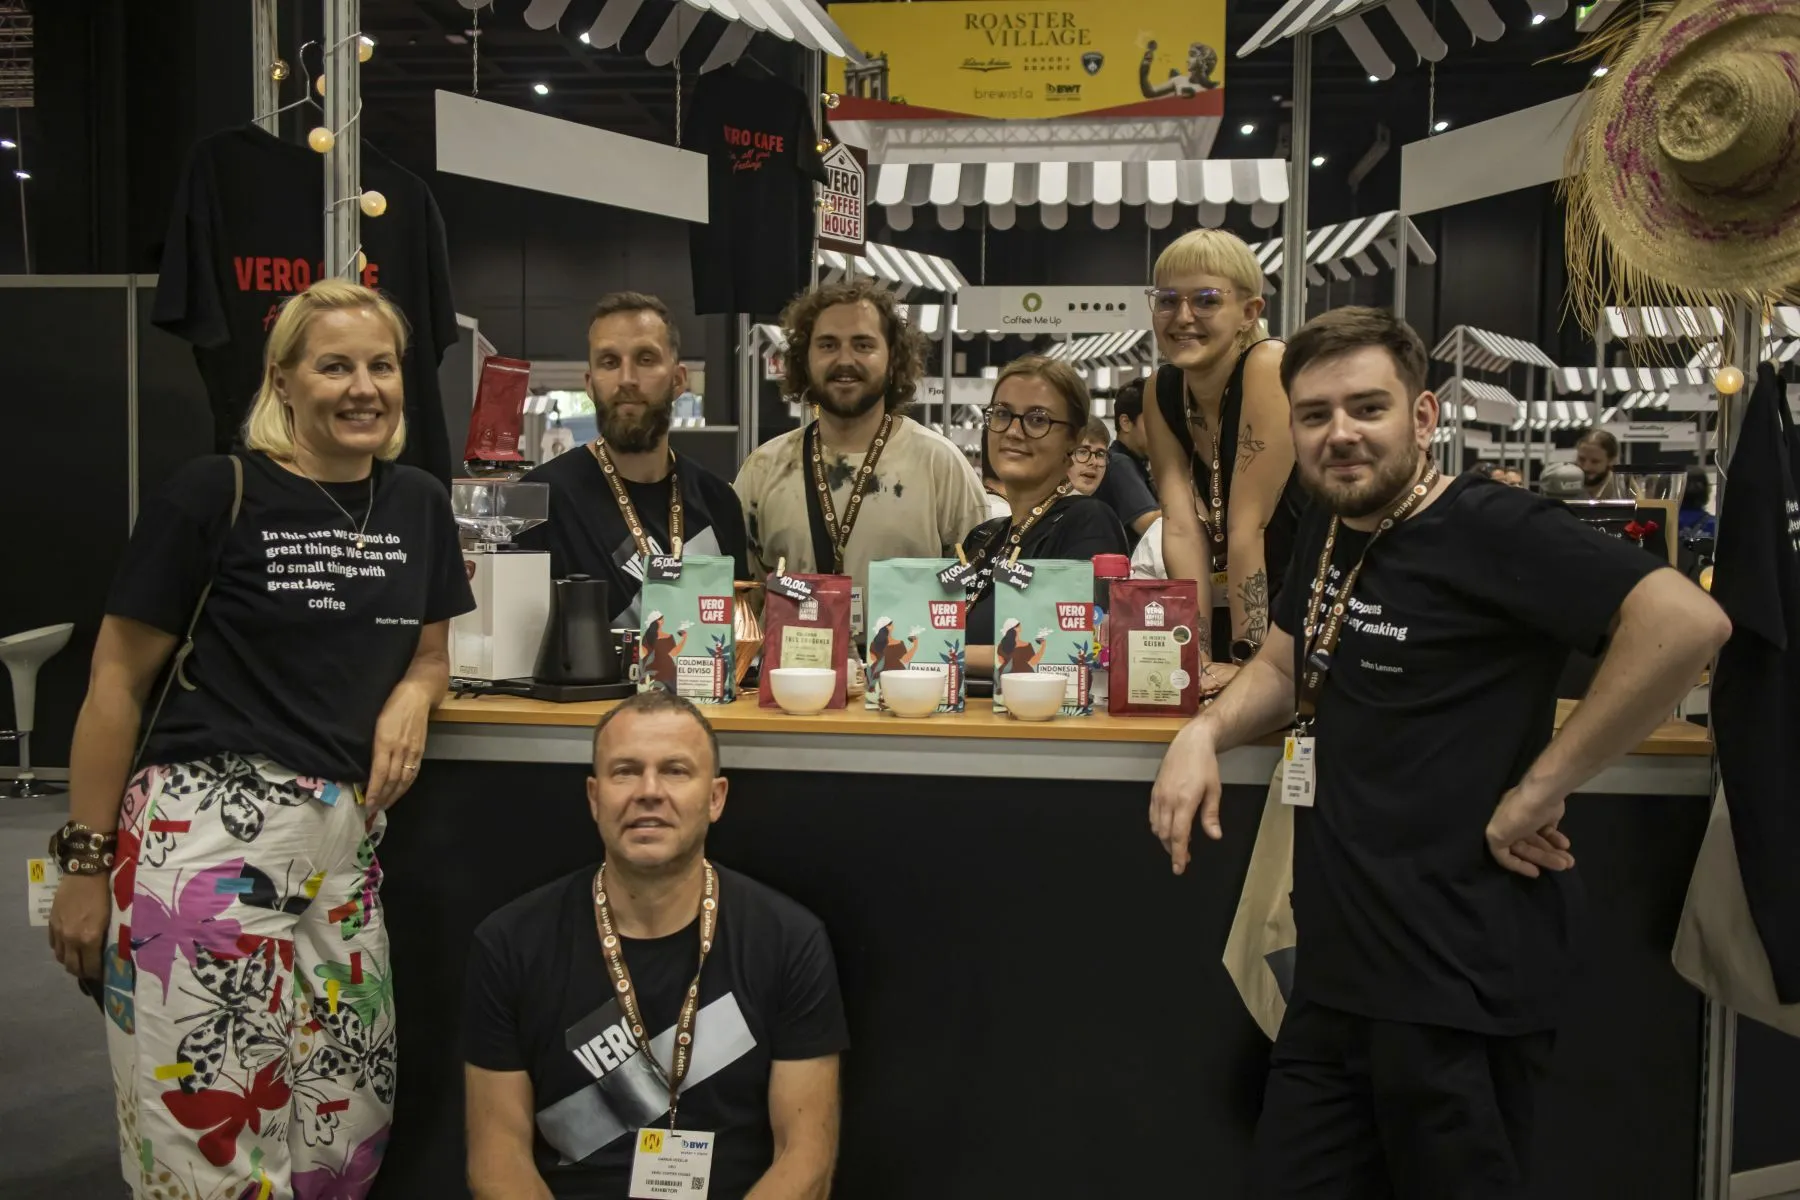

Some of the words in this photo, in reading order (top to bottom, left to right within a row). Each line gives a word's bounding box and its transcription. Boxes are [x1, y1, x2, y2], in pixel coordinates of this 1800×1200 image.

[965, 12, 1076, 30] ROASTER
[985, 29, 1092, 46] VILLAGE
[974, 87, 1033, 99] brewista
[1056, 84, 1081, 93] BWT
[755, 132, 784, 152] CAFE
[826, 168, 859, 195] VERO
[824, 214, 859, 237] HOUSE
[234, 256, 311, 292] VERO
[1002, 315, 1032, 324] Coffee
[1034, 316, 1048, 324] Me
[1049, 316, 1062, 327] Up
[1393, 493, 1417, 517] cafetto
[626, 505, 638, 528] cafetto
[1019, 516, 1035, 536] cafetto
[261, 530, 279, 541] In
[280, 531, 307, 540] this
[332, 529, 348, 540] We
[385, 533, 400, 544] do
[265, 544, 303, 558] great
[304, 543, 345, 558] things.
[346, 546, 362, 559] We
[364, 550, 383, 561] can
[385, 549, 408, 563] only
[267, 561, 284, 573] do
[287, 561, 325, 573] small
[326, 561, 358, 577] things
[359, 565, 386, 577] with
[267, 580, 304, 591] great
[308, 597, 346, 610] coffee
[700, 599, 725, 610] VERO
[931, 603, 957, 614] VERO
[1059, 605, 1085, 616] VERO
[1348, 597, 1382, 615] appens
[375, 617, 399, 625] Mother
[400, 617, 419, 625] Teresa
[702, 610, 725, 622] CAFE
[934, 615, 957, 627] CAFE
[1062, 617, 1085, 629] CAFE
[1322, 616, 1338, 645] cafetto
[1362, 621, 1408, 641] making
[1040, 665, 1078, 673] INDONESIA
[1360, 659, 1374, 669] John
[1375, 663, 1403, 673] Lennon
[705, 868, 714, 895] cafetto
[601, 906, 613, 934] cafetto
[703, 910, 714, 938] cafetto
[610, 950, 624, 979] cafetto
[624, 994, 637, 1024] cafetto
[683, 998, 694, 1029] cafetto
[677, 1046, 687, 1077] cafetto
[690, 1141, 709, 1149] BWT
